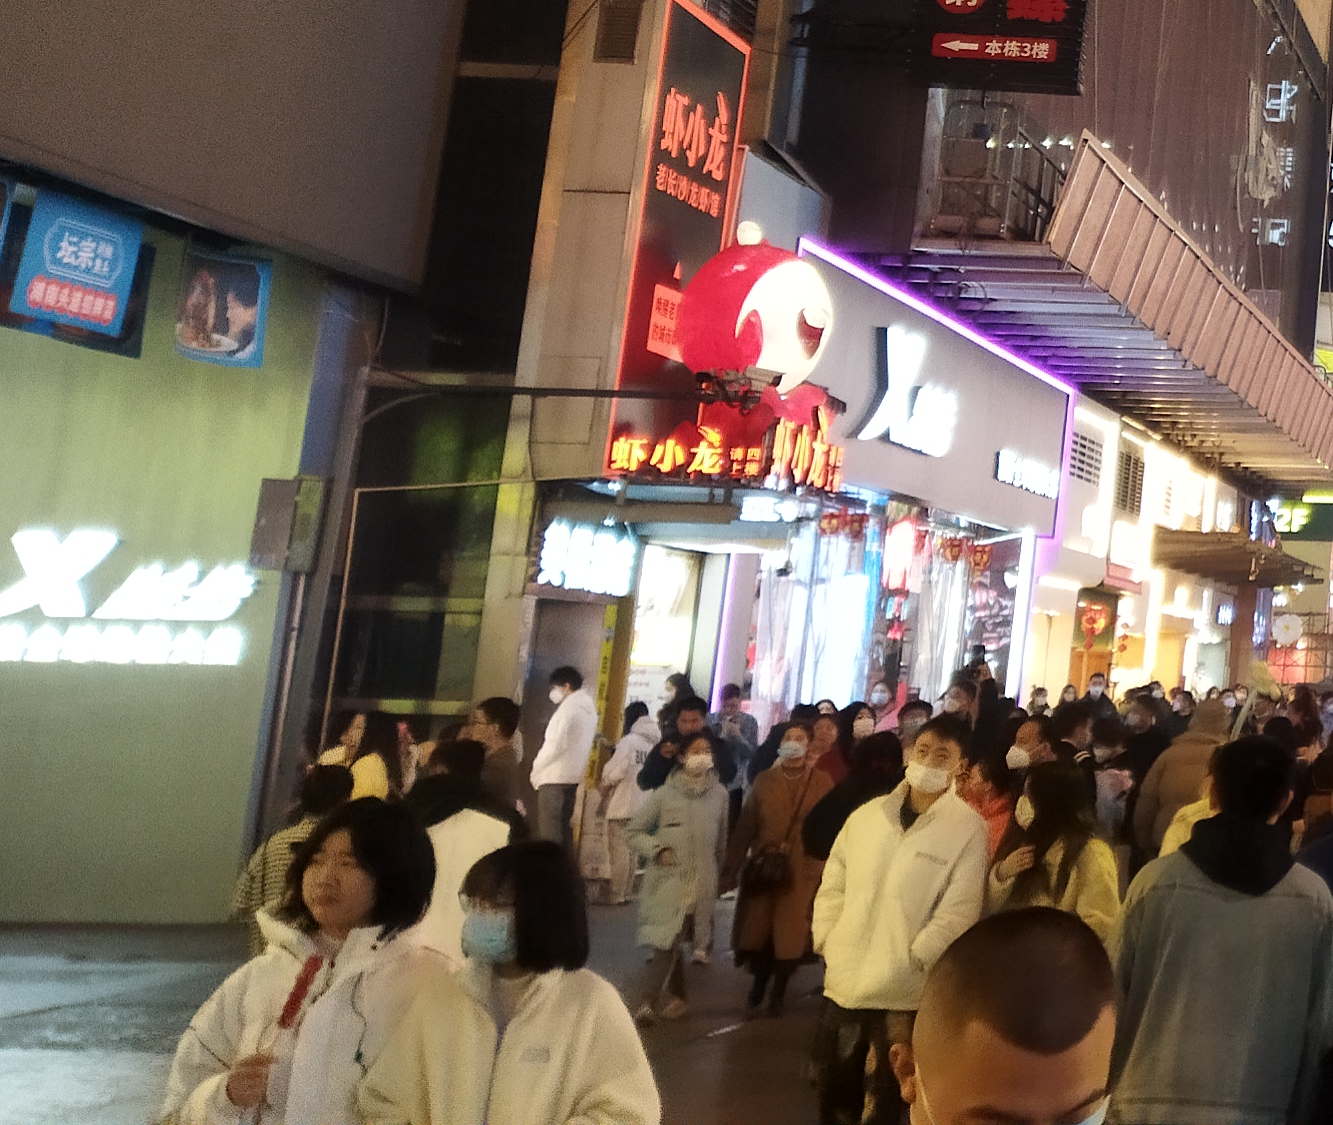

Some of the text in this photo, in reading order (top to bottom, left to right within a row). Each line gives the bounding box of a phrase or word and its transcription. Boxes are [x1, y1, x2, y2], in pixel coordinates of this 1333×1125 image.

[984, 39, 1050, 60] 本栋3楼
[660, 87, 731, 182] 虾小龙
[610, 426, 723, 474] 虾小龙
[1275, 507, 1309, 533] 2F
